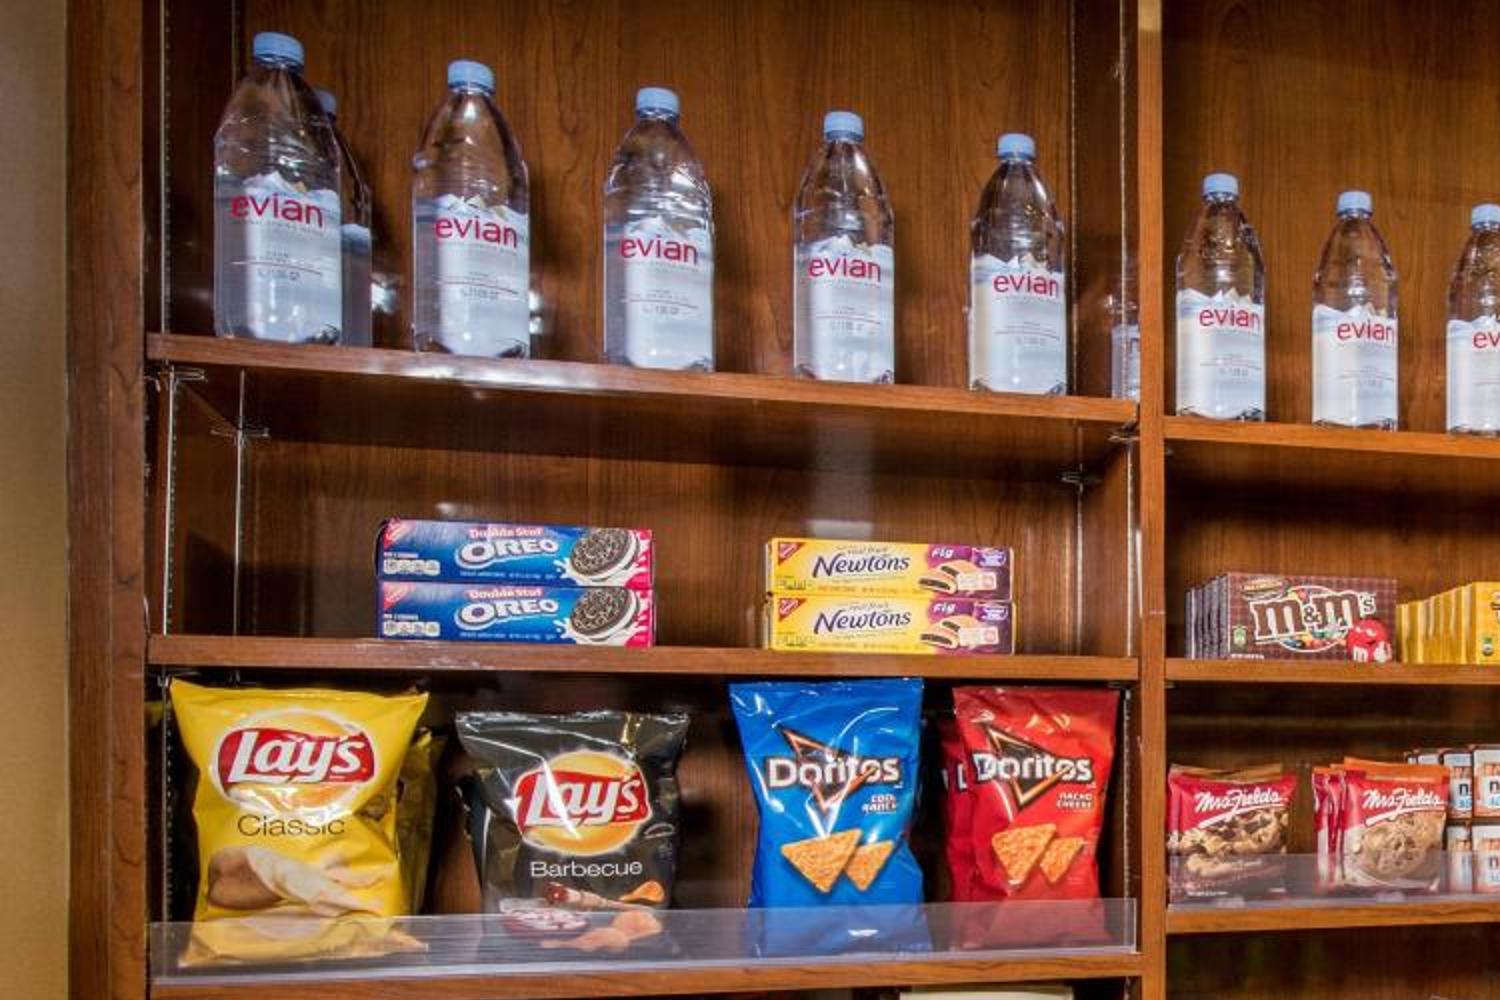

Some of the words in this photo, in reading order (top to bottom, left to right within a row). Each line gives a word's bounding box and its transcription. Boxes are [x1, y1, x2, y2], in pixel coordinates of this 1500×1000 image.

[230, 194, 324, 229] evian
[433, 215, 519, 250] evian
[619, 233, 699, 265] evian
[807, 252, 881, 283] evian
[992, 272, 1060, 298] evian
[1199, 304, 1261, 329] evian
[1336, 318, 1396, 342] evian
[456, 537, 560, 570] OREO
[812, 552, 910, 578] Newtons
[455, 598, 559, 631] OREO
[813, 609, 911, 635] Newtons
[227, 731, 368, 784] Lay's
[767, 756, 901, 788] Doritos
[973, 752, 1093, 782] Doritos
[523, 774, 642, 827] Lay's
[237, 814, 346, 837] Classic
[530, 861, 643, 878] Barbecue
